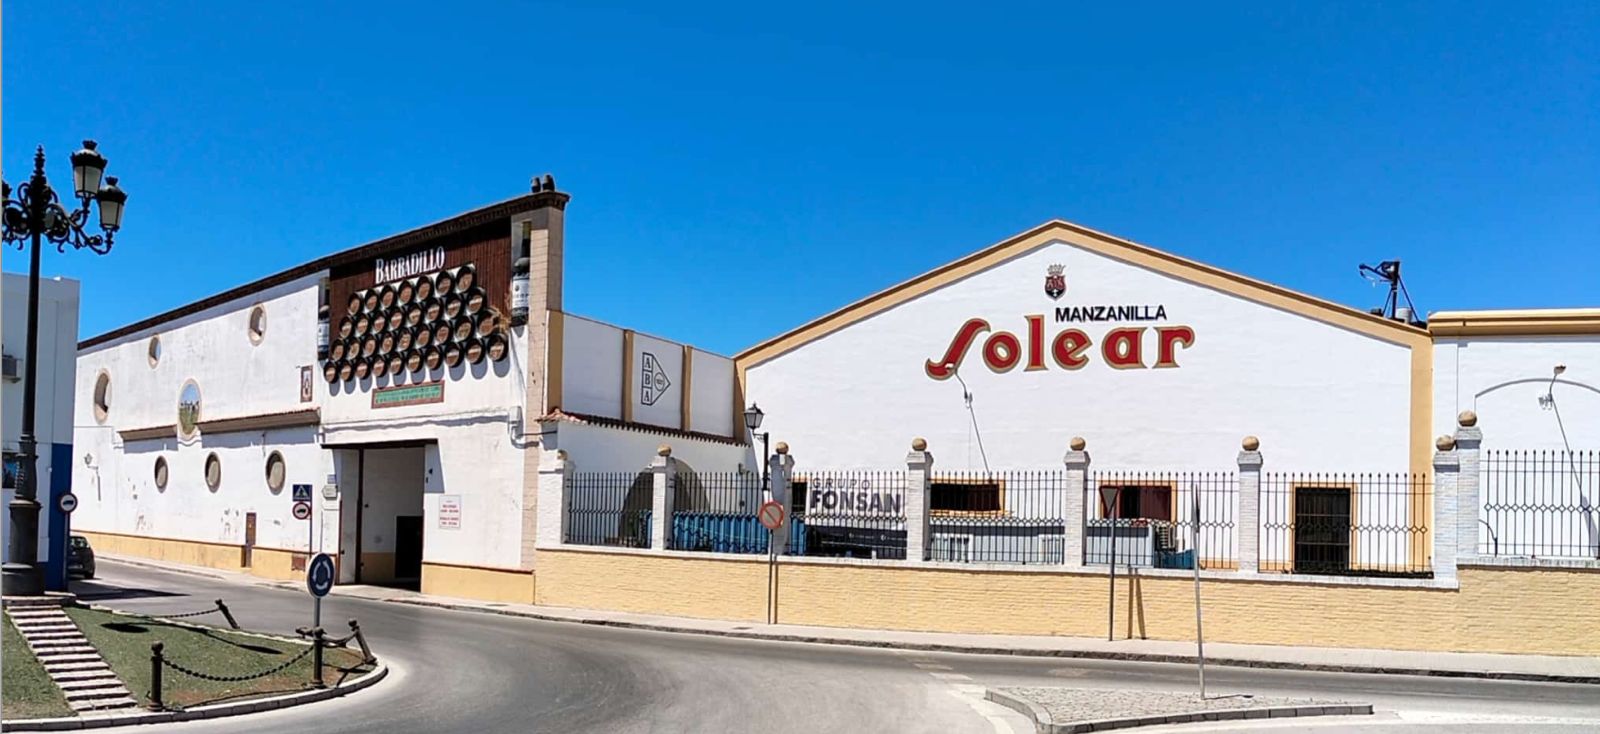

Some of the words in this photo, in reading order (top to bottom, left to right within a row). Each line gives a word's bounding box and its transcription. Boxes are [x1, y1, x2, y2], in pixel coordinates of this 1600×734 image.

[375, 246, 445, 284] BARBADILLO
[1055, 305, 1167, 322] MANZANILLA
[925, 314, 1195, 380] Solear
[813, 478, 870, 489] GRUPO
[810, 490, 901, 513] FONSAN
